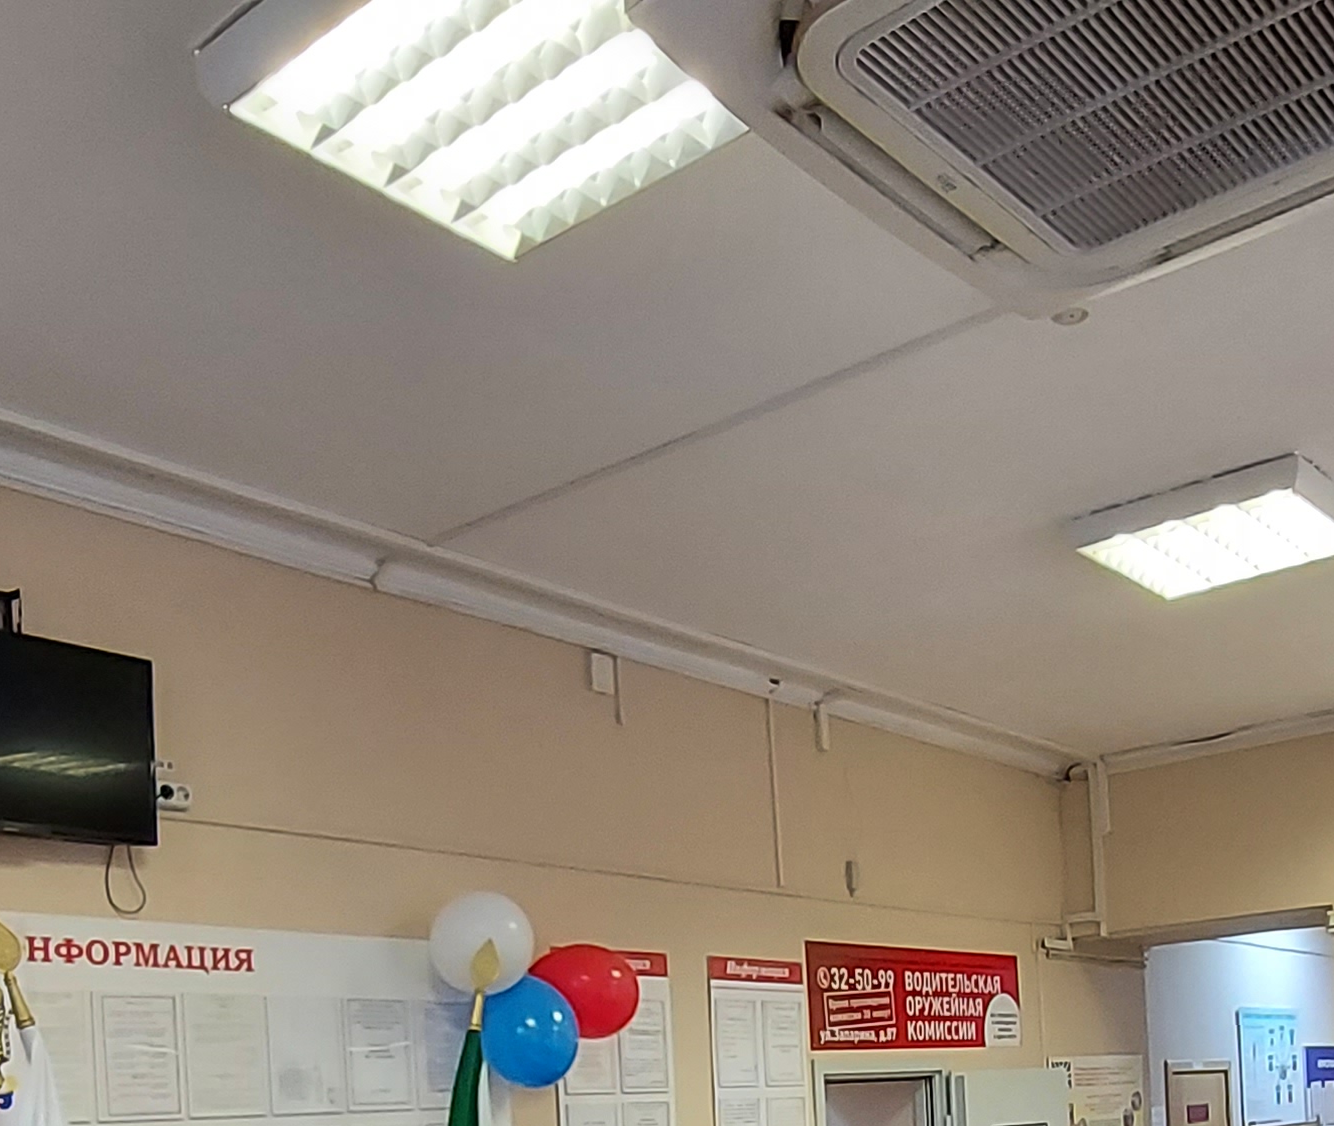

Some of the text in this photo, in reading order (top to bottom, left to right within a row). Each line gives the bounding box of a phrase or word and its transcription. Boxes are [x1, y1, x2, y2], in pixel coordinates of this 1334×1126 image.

[25, 936, 255, 974] НФОРМАЦИЯ
[830, 967, 1001, 995] 32-50-99 ВОДИТЕЛЬСКАЯ
[906, 993, 984, 1018] ОРУЖЕЙНАЯ
[907, 1020, 977, 1041] КОМИССИИ
